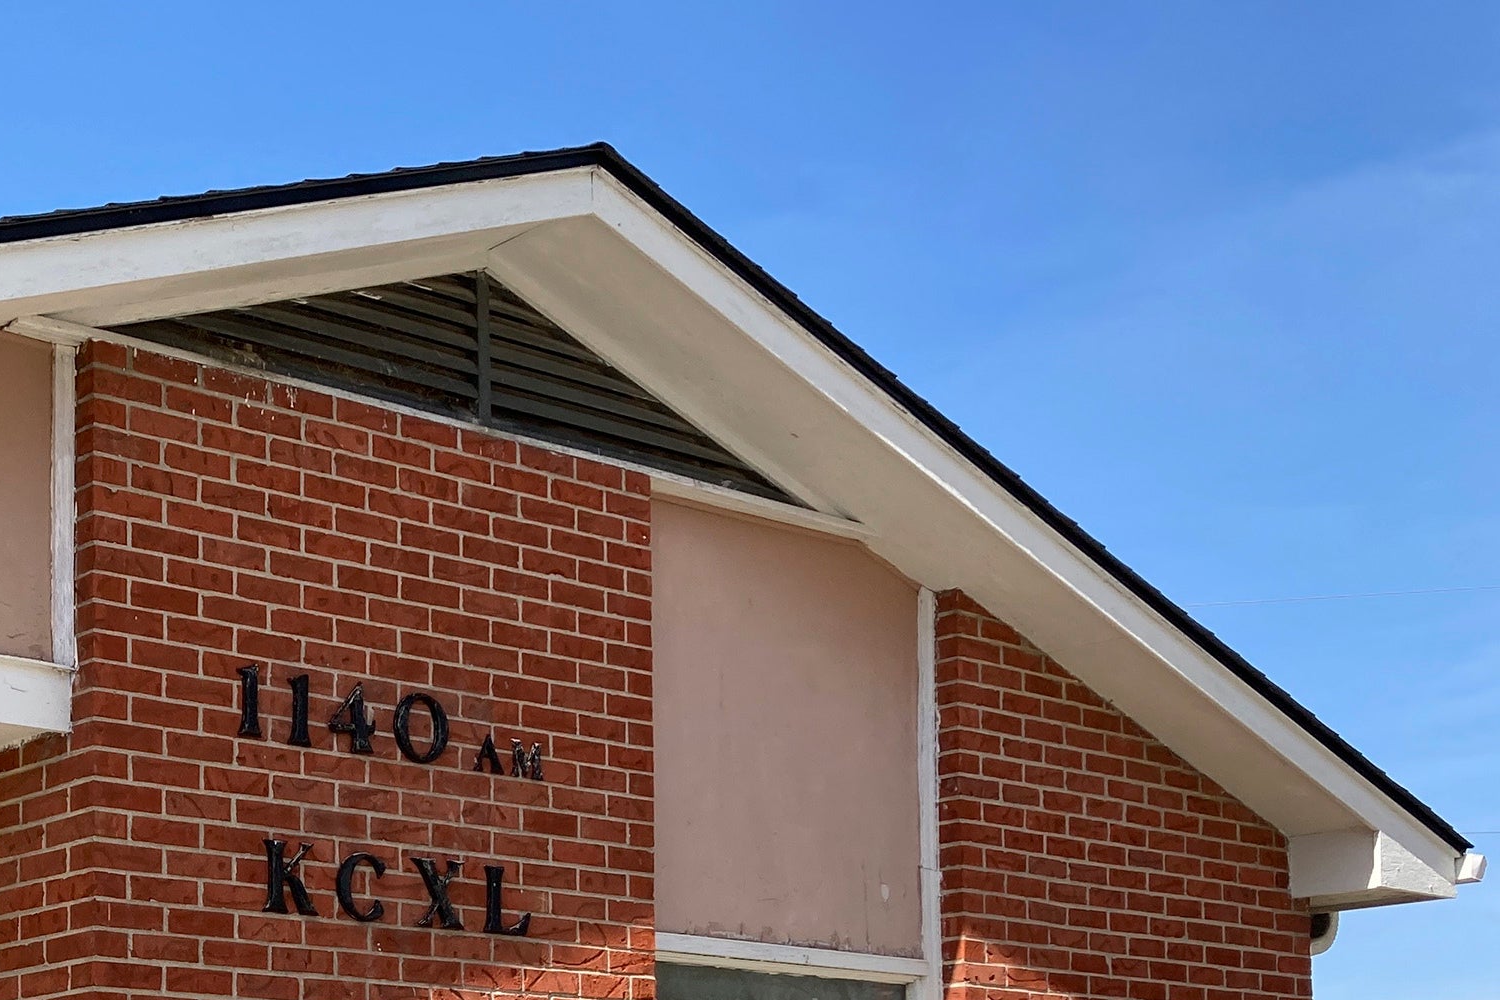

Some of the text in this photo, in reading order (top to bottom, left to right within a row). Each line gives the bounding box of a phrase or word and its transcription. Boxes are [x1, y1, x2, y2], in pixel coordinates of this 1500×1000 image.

[236, 663, 544, 781] 1140 AM
[262, 838, 531, 935] KCXL
